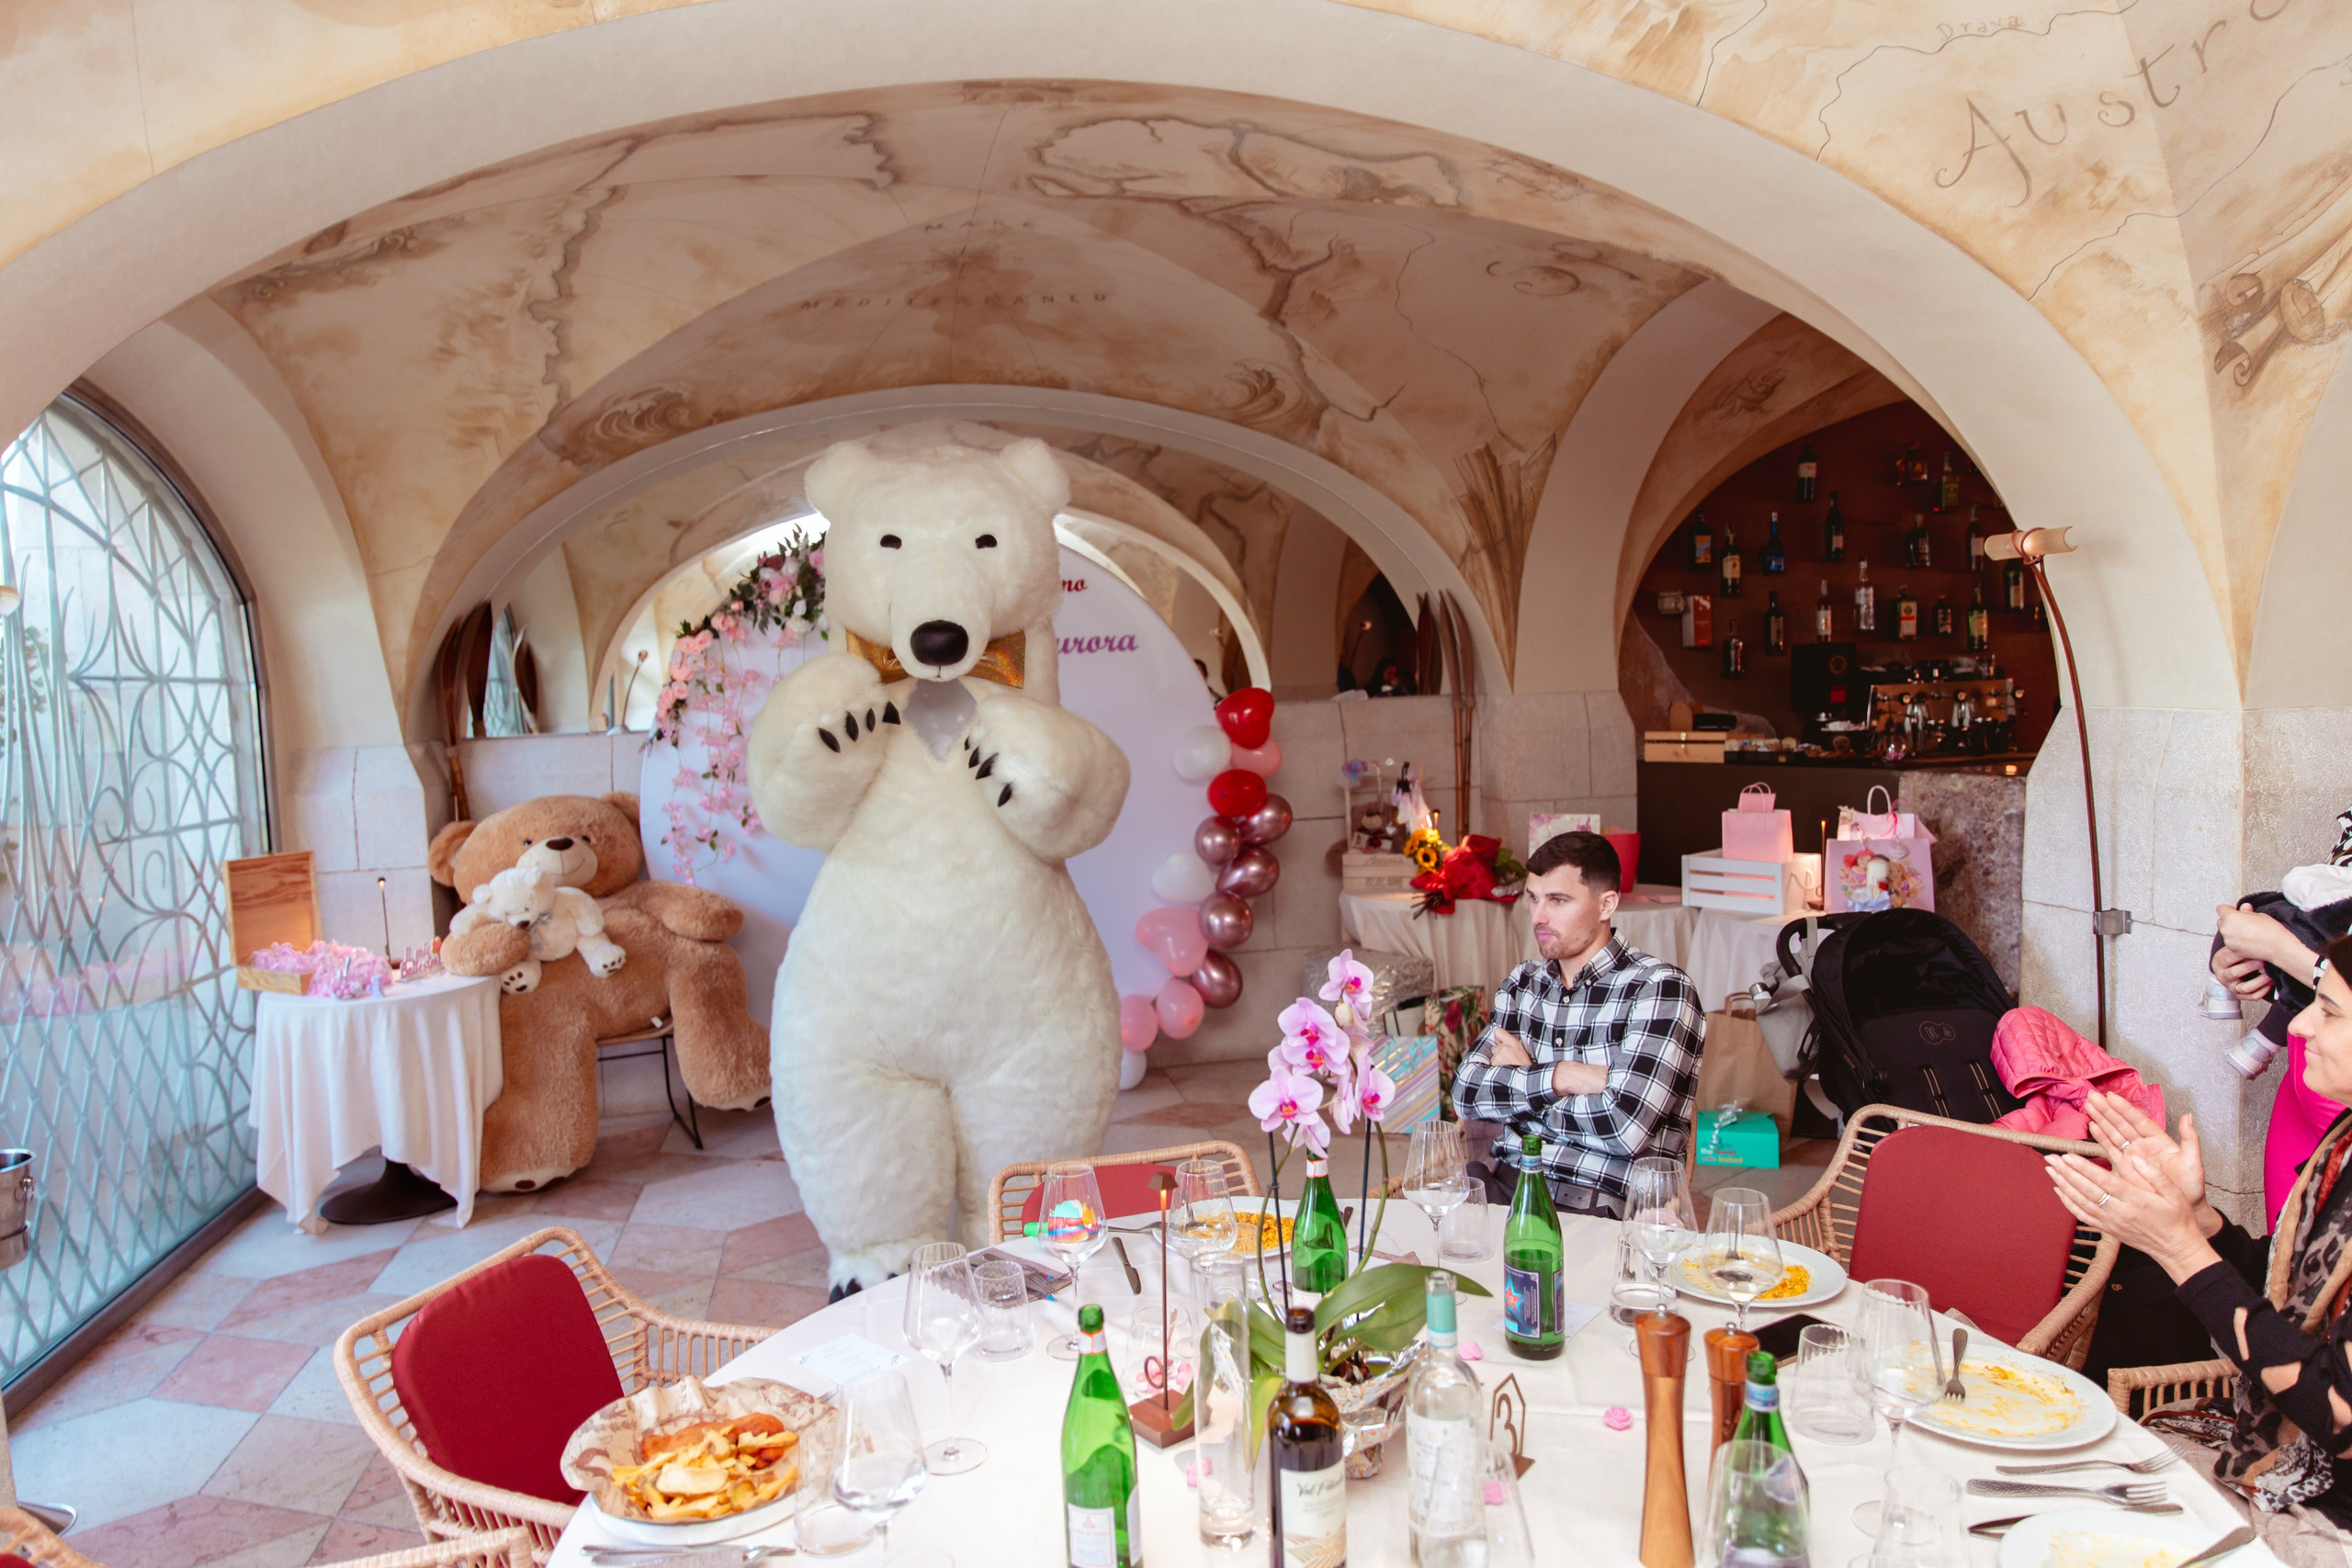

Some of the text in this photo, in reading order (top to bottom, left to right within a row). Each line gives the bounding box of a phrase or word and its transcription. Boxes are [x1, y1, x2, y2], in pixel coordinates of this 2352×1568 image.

[1936, 16, 2022, 42] Drava
[800, 292, 1107, 310] MEDITERRANEO
[1057, 634, 1139, 655] urora
